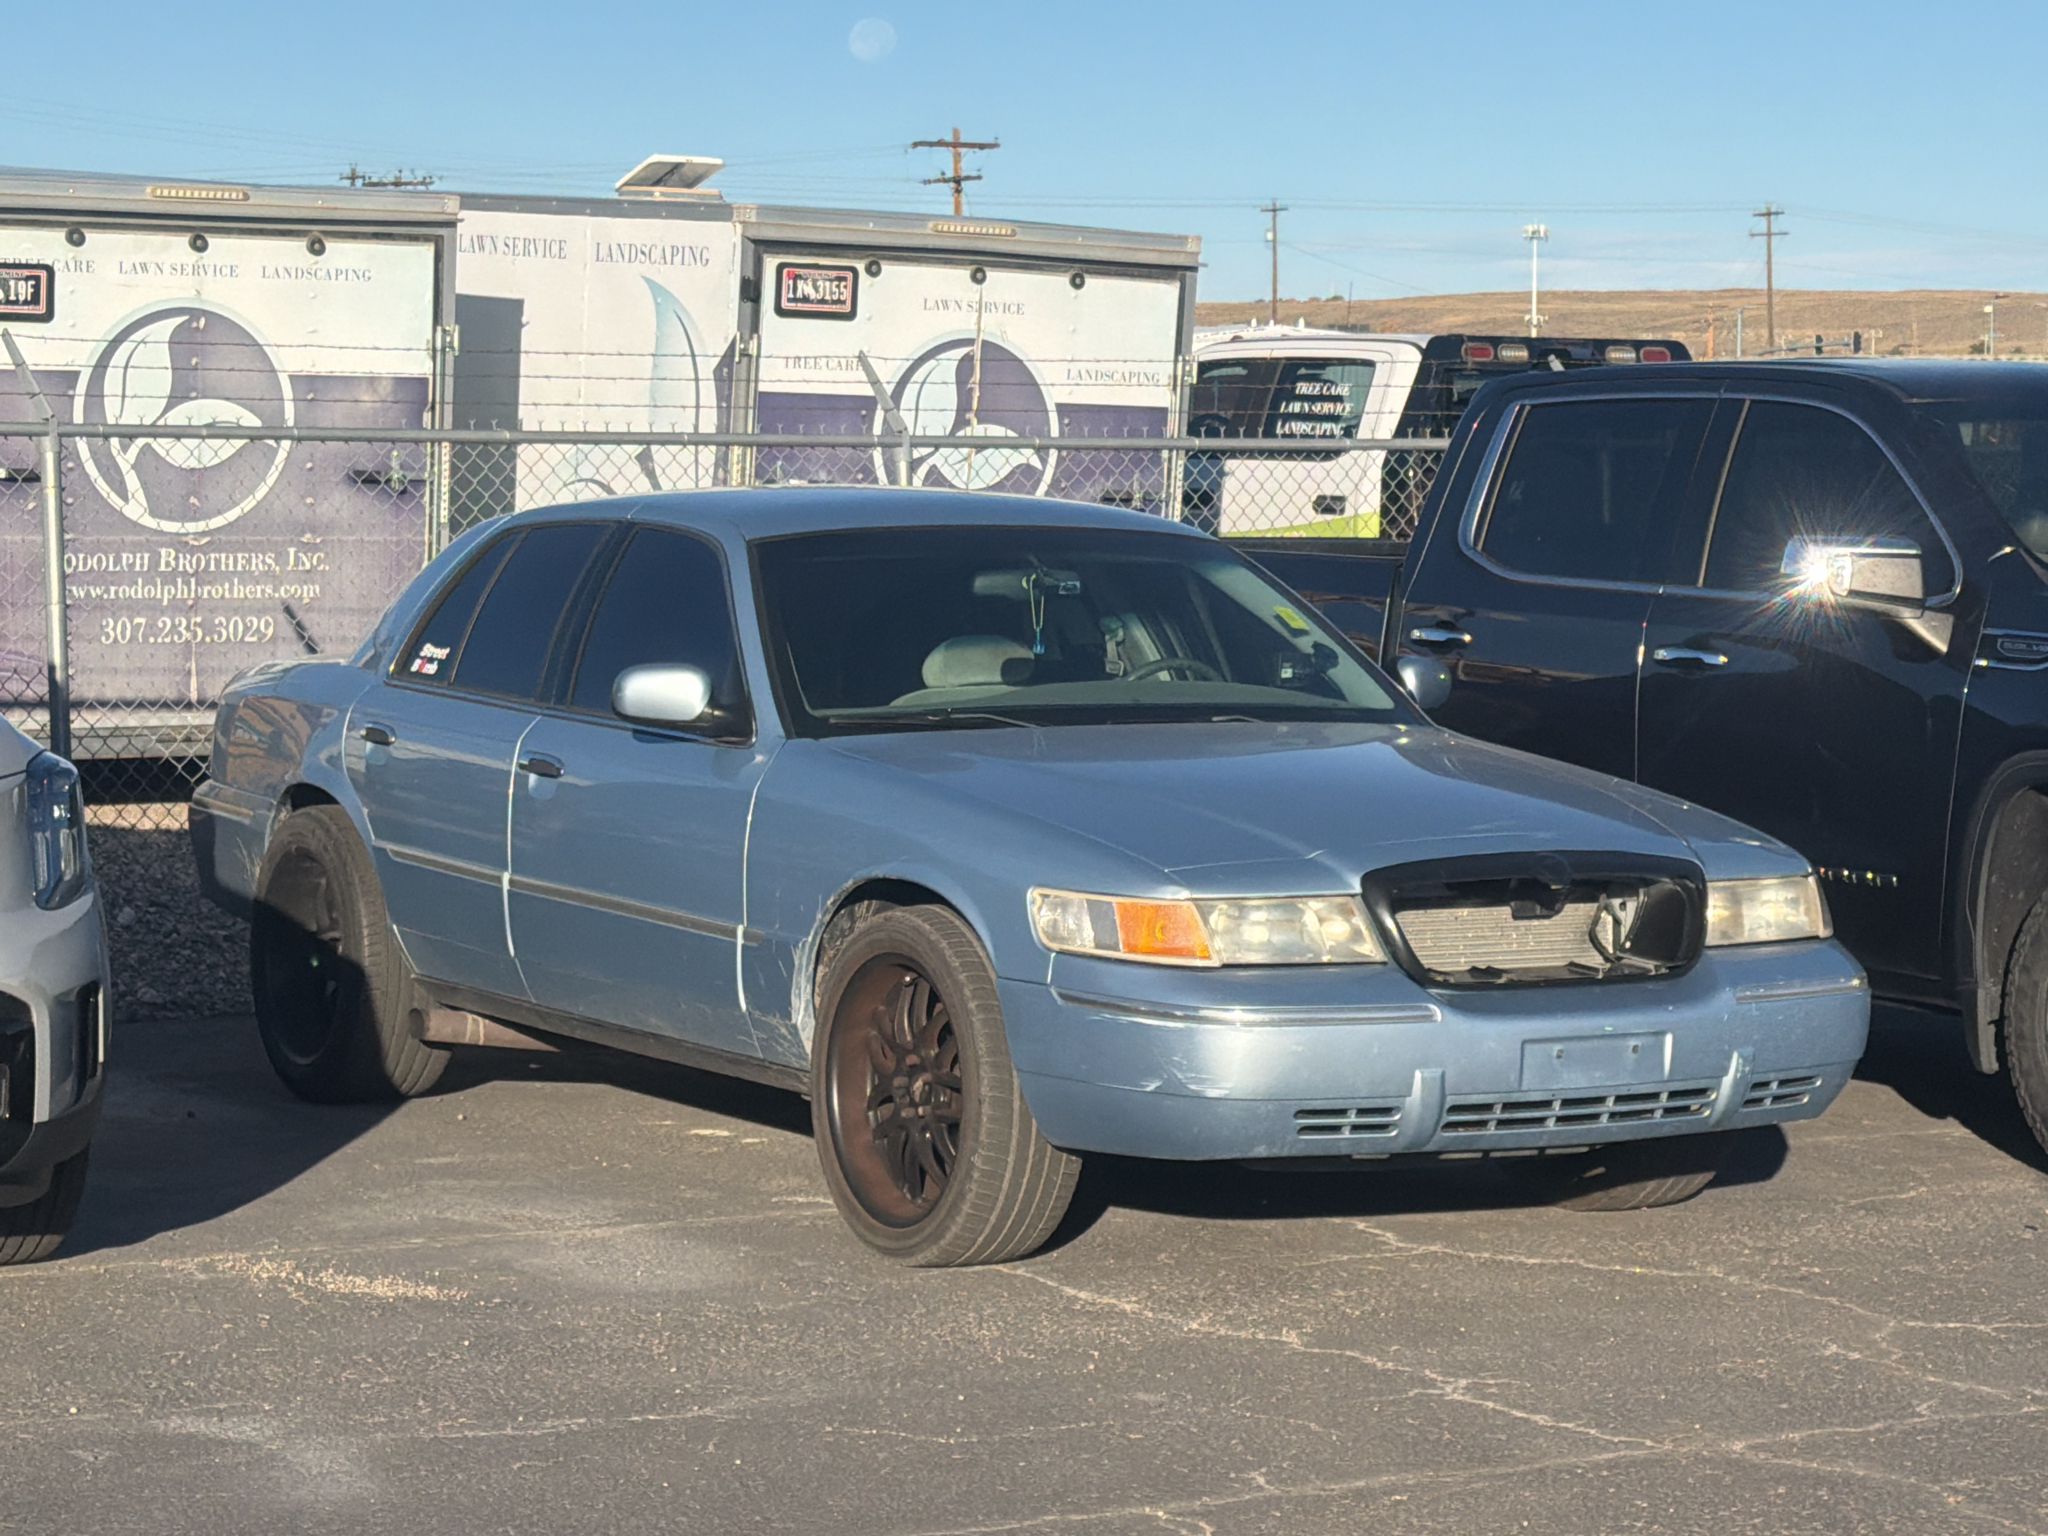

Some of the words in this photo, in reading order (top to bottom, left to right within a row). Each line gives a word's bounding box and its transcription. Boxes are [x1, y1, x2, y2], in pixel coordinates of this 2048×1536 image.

[458, 233, 498, 255] LAWN
[503, 235, 566, 260] SERVICE
[595, 242, 710, 268] LANDSCAPING
[52, 259, 95, 274] CARE
[118, 260, 164, 277] LAWN
[169, 262, 239, 279] SERVICE
[261, 265, 372, 283] LANDSCAPING
[923, 298, 963, 313] LAWN
[784, 356, 823, 371] TREE
[1066, 367, 1161, 385] LANDSCAPING
[1295, 382, 1324, 395] TREE
[1322, 383, 1352, 396] CARE
[1280, 401, 1310, 414] LAWN
[1275, 419, 1346, 436] LANDSCAPING
[63, 552, 150, 573] ODOLPH
[66, 577, 321, 606] ww.rodolphbrothers.com
[100, 616, 275, 644] 307.235.3029
